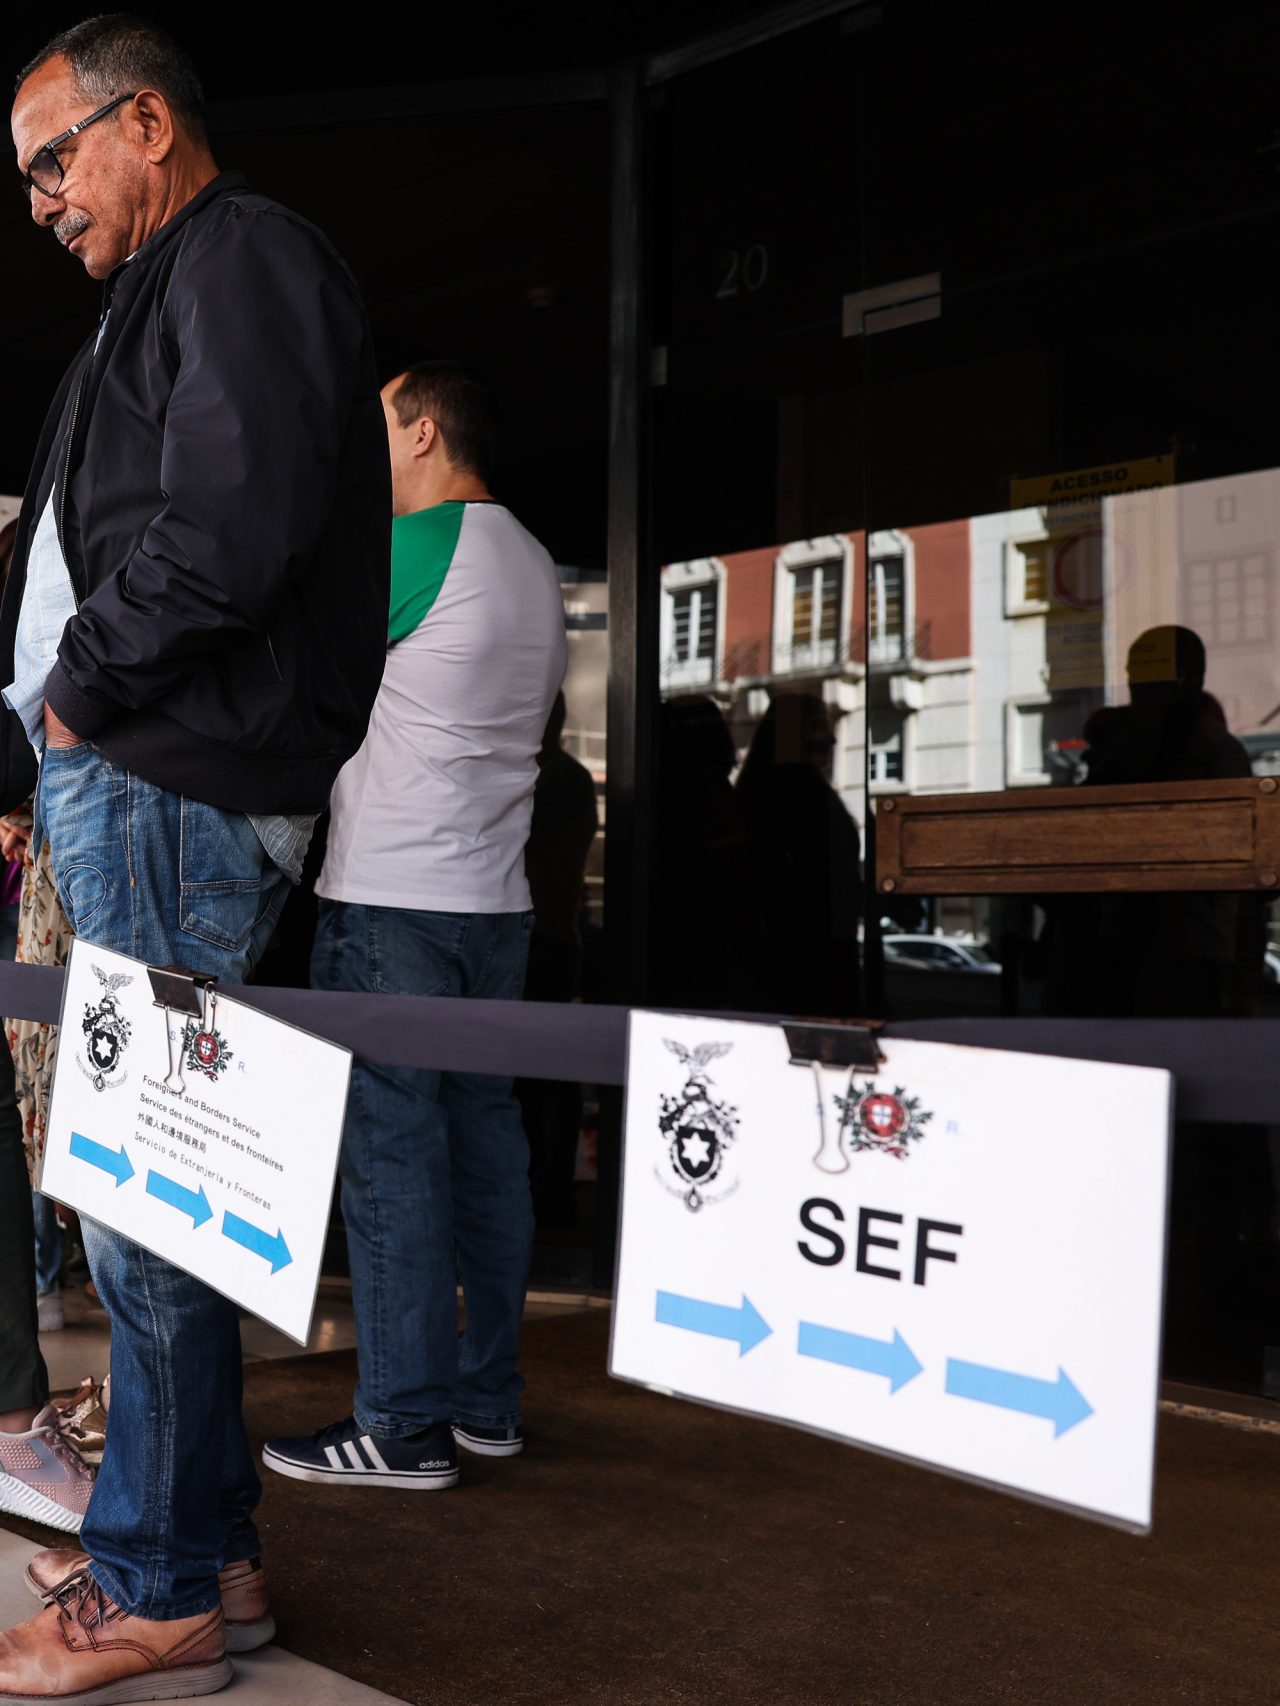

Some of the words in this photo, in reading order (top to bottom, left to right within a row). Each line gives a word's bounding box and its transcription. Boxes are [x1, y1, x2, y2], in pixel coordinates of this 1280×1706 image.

[714, 242, 769, 299] 20
[1050, 467, 1129, 492] ACESSO
[140, 1093, 167, 1112] Service
[169, 1107, 182, 1120] des
[184, 1114, 220, 1139] étrangers
[221, 1134, 230, 1144] et
[230, 1138, 244, 1152] des
[246, 1145, 284, 1172] fronteires
[184, 1096, 198, 1107] and
[200, 1101, 230, 1123] Borders
[232, 1117, 261, 1139] Service
[134, 1131, 166, 1154] Servicio
[168, 1149, 178, 1160] de
[234, 1182, 271, 1210] Fronteras
[797, 1197, 964, 1287] SEF
[418, 1459, 451, 1470] adidas
